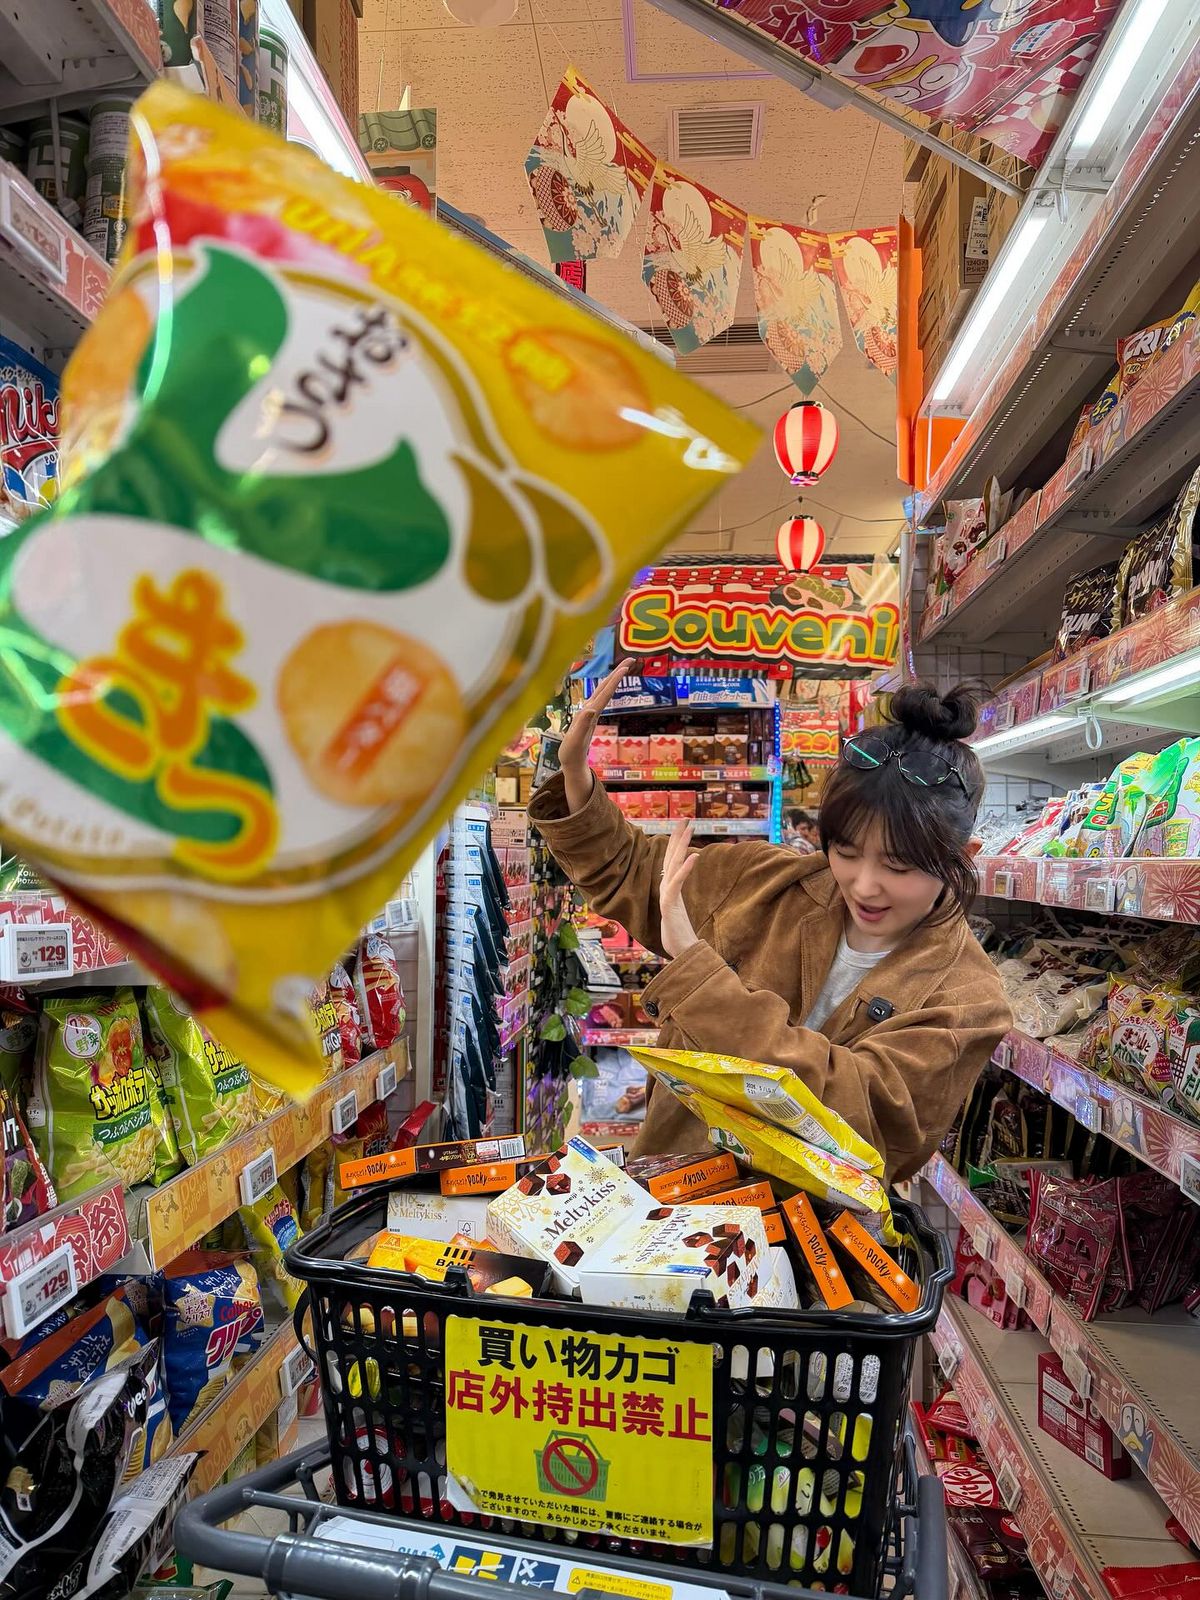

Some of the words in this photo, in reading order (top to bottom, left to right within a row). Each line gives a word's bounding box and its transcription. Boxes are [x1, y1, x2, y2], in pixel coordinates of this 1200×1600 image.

[38, 945, 66, 962] 129
[544, 1180, 618, 1242] Meltykiss
[564, 1192, 578, 1206] meiji
[399, 1208, 443, 1222] Meltykiss
[635, 1207, 692, 1263] Meltykiss
[39, 1269, 68, 1299] 129
[822, 1266, 838, 1296] CHOCOLATE
[888, 1276, 911, 1301] CHOCOLATE
[477, 1325, 681, 1386] 買い物カゴ
[446, 1369, 712, 1443] 店外持出禁止
[481, 1500, 672, 1541] ございますので、あらかじめご了承くださいませ。
